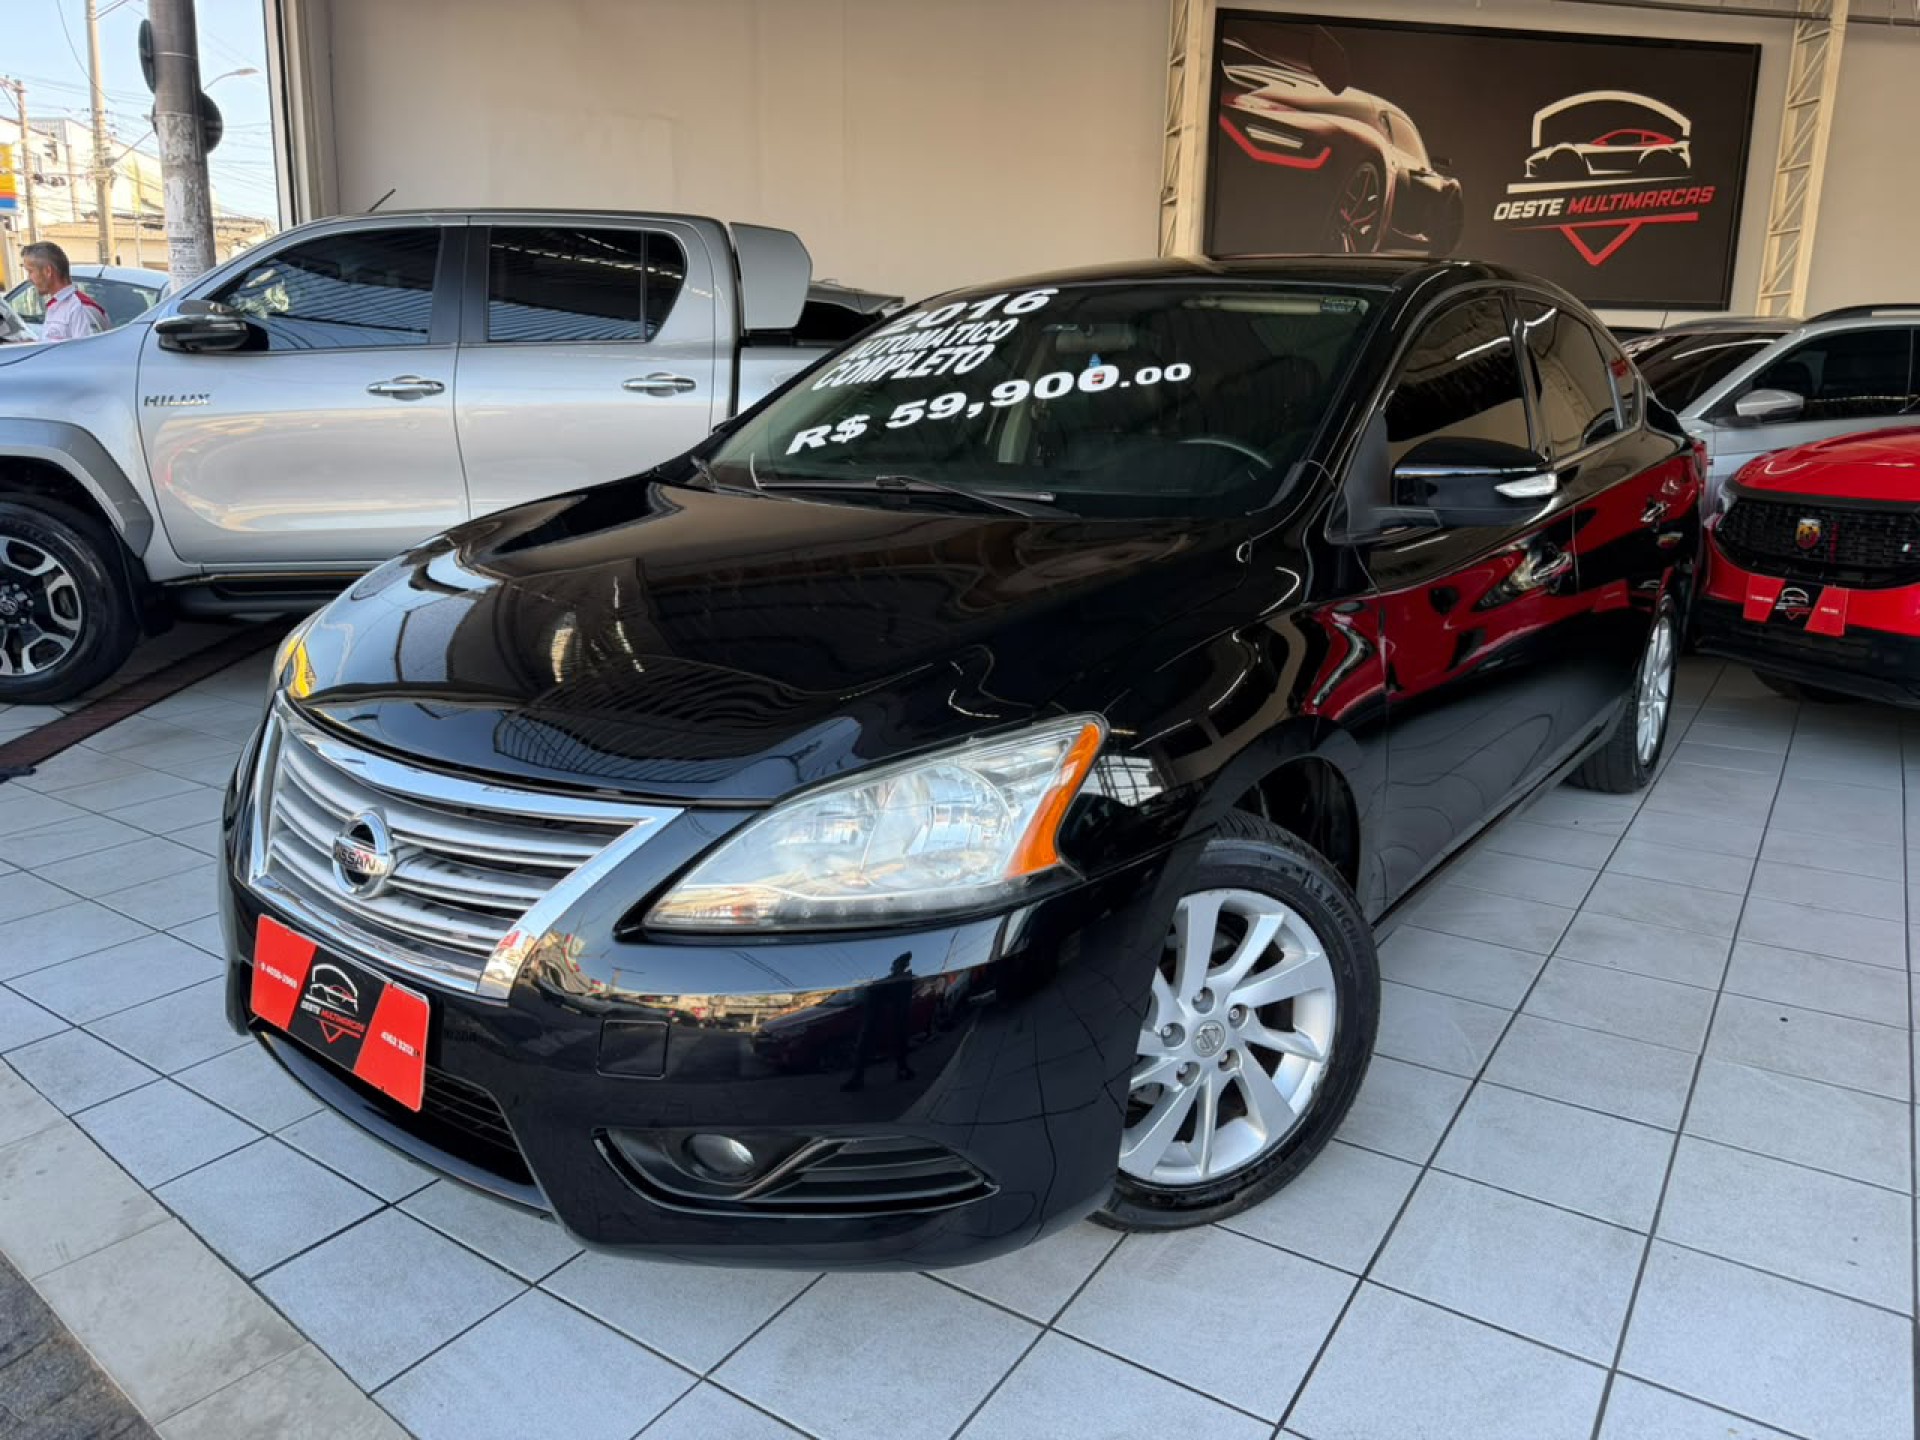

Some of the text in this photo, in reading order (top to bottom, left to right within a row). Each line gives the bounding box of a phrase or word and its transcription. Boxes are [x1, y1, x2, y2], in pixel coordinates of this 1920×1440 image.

[1493, 185, 1716, 221] OESTE MULTIMARCAS
[870, 287, 1059, 337] 2016
[811, 344, 995, 391] COMPLETO
[144, 393, 211, 407] HILUX
[786, 363, 1191, 456] R$ 59,900.00
